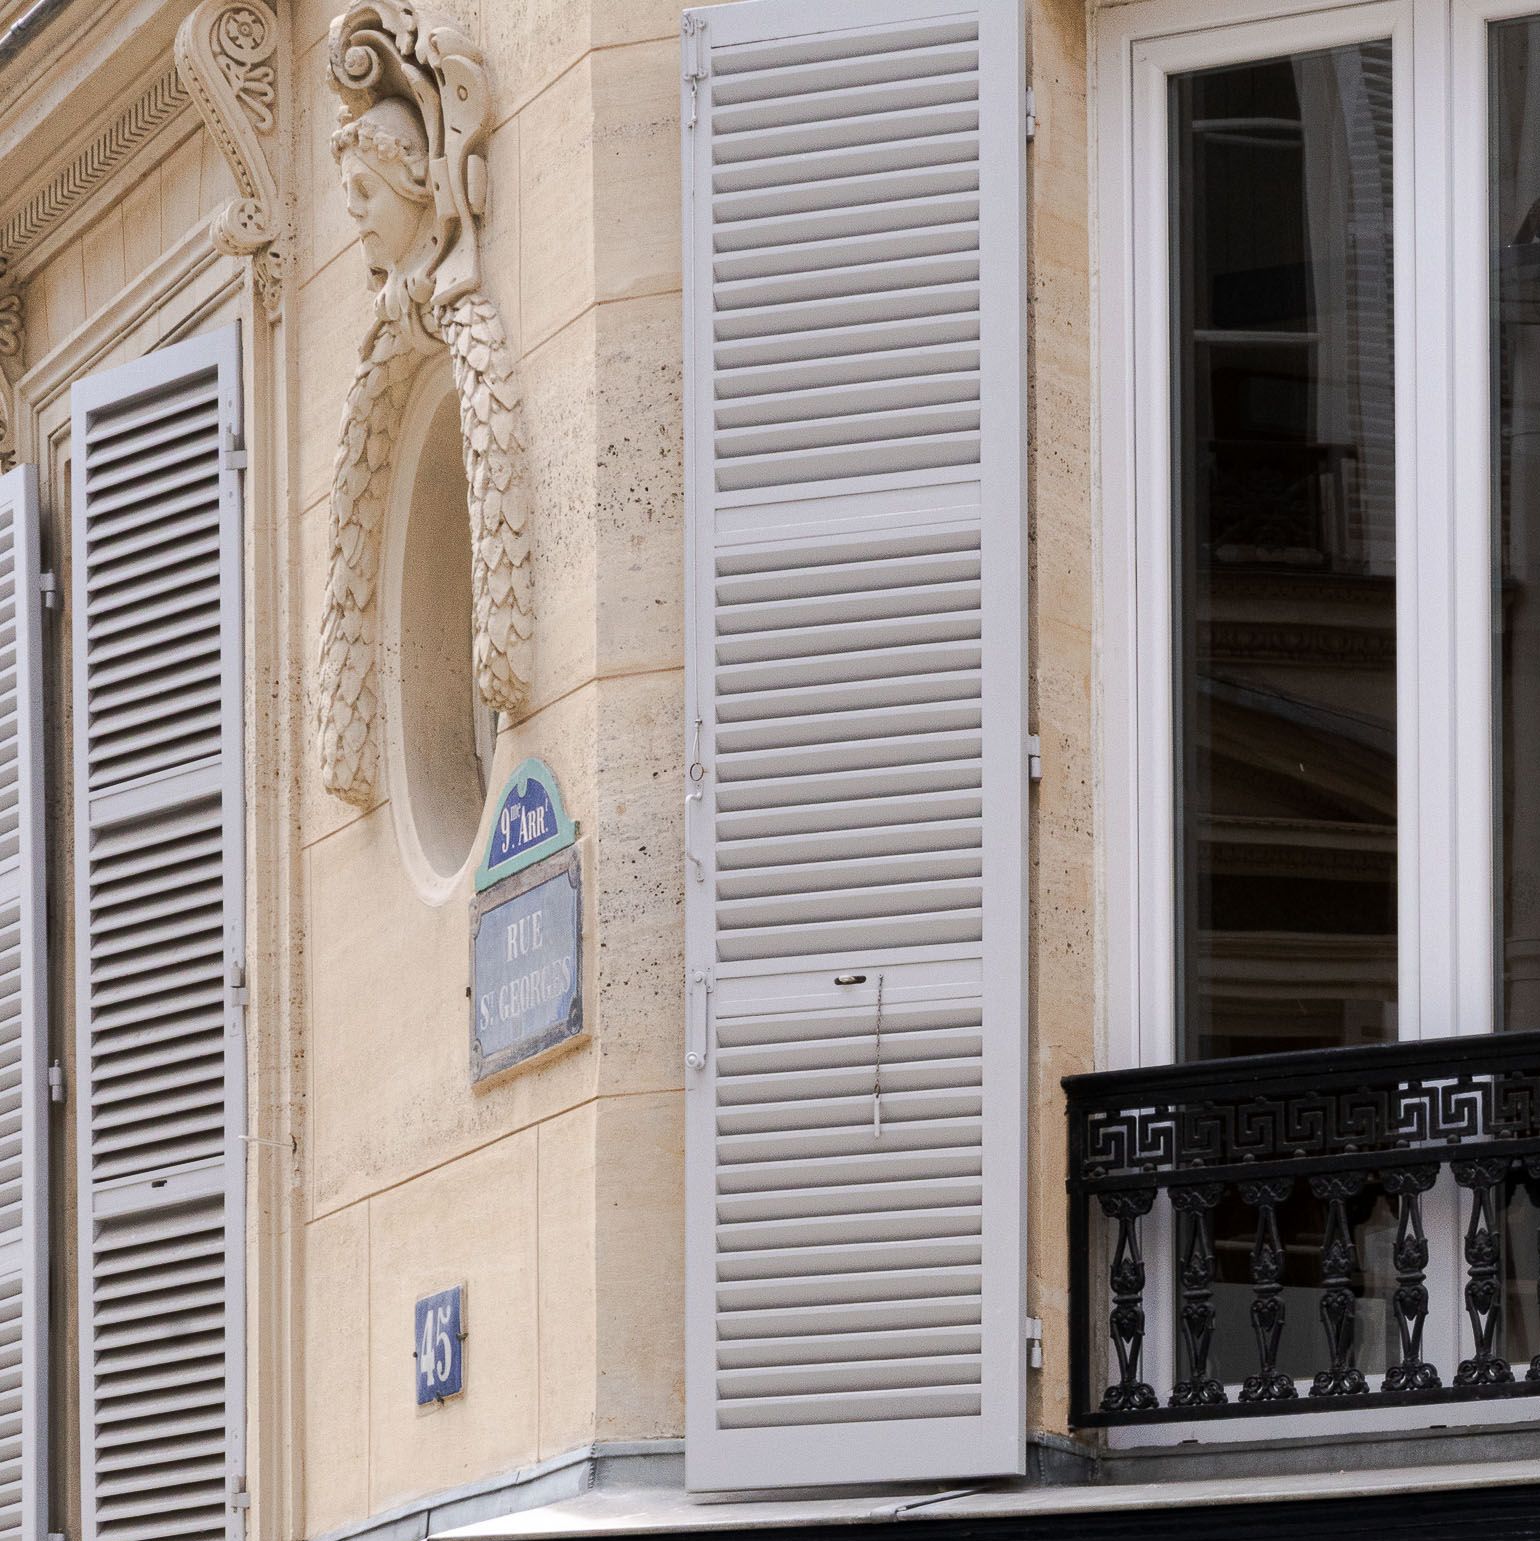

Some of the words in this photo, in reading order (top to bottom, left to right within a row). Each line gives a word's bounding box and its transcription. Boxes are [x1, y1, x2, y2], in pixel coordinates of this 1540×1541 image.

[505, 910, 543, 963] RUE
[498, 956, 571, 1022] GEORGES
[421, 1304, 452, 1386] 45
